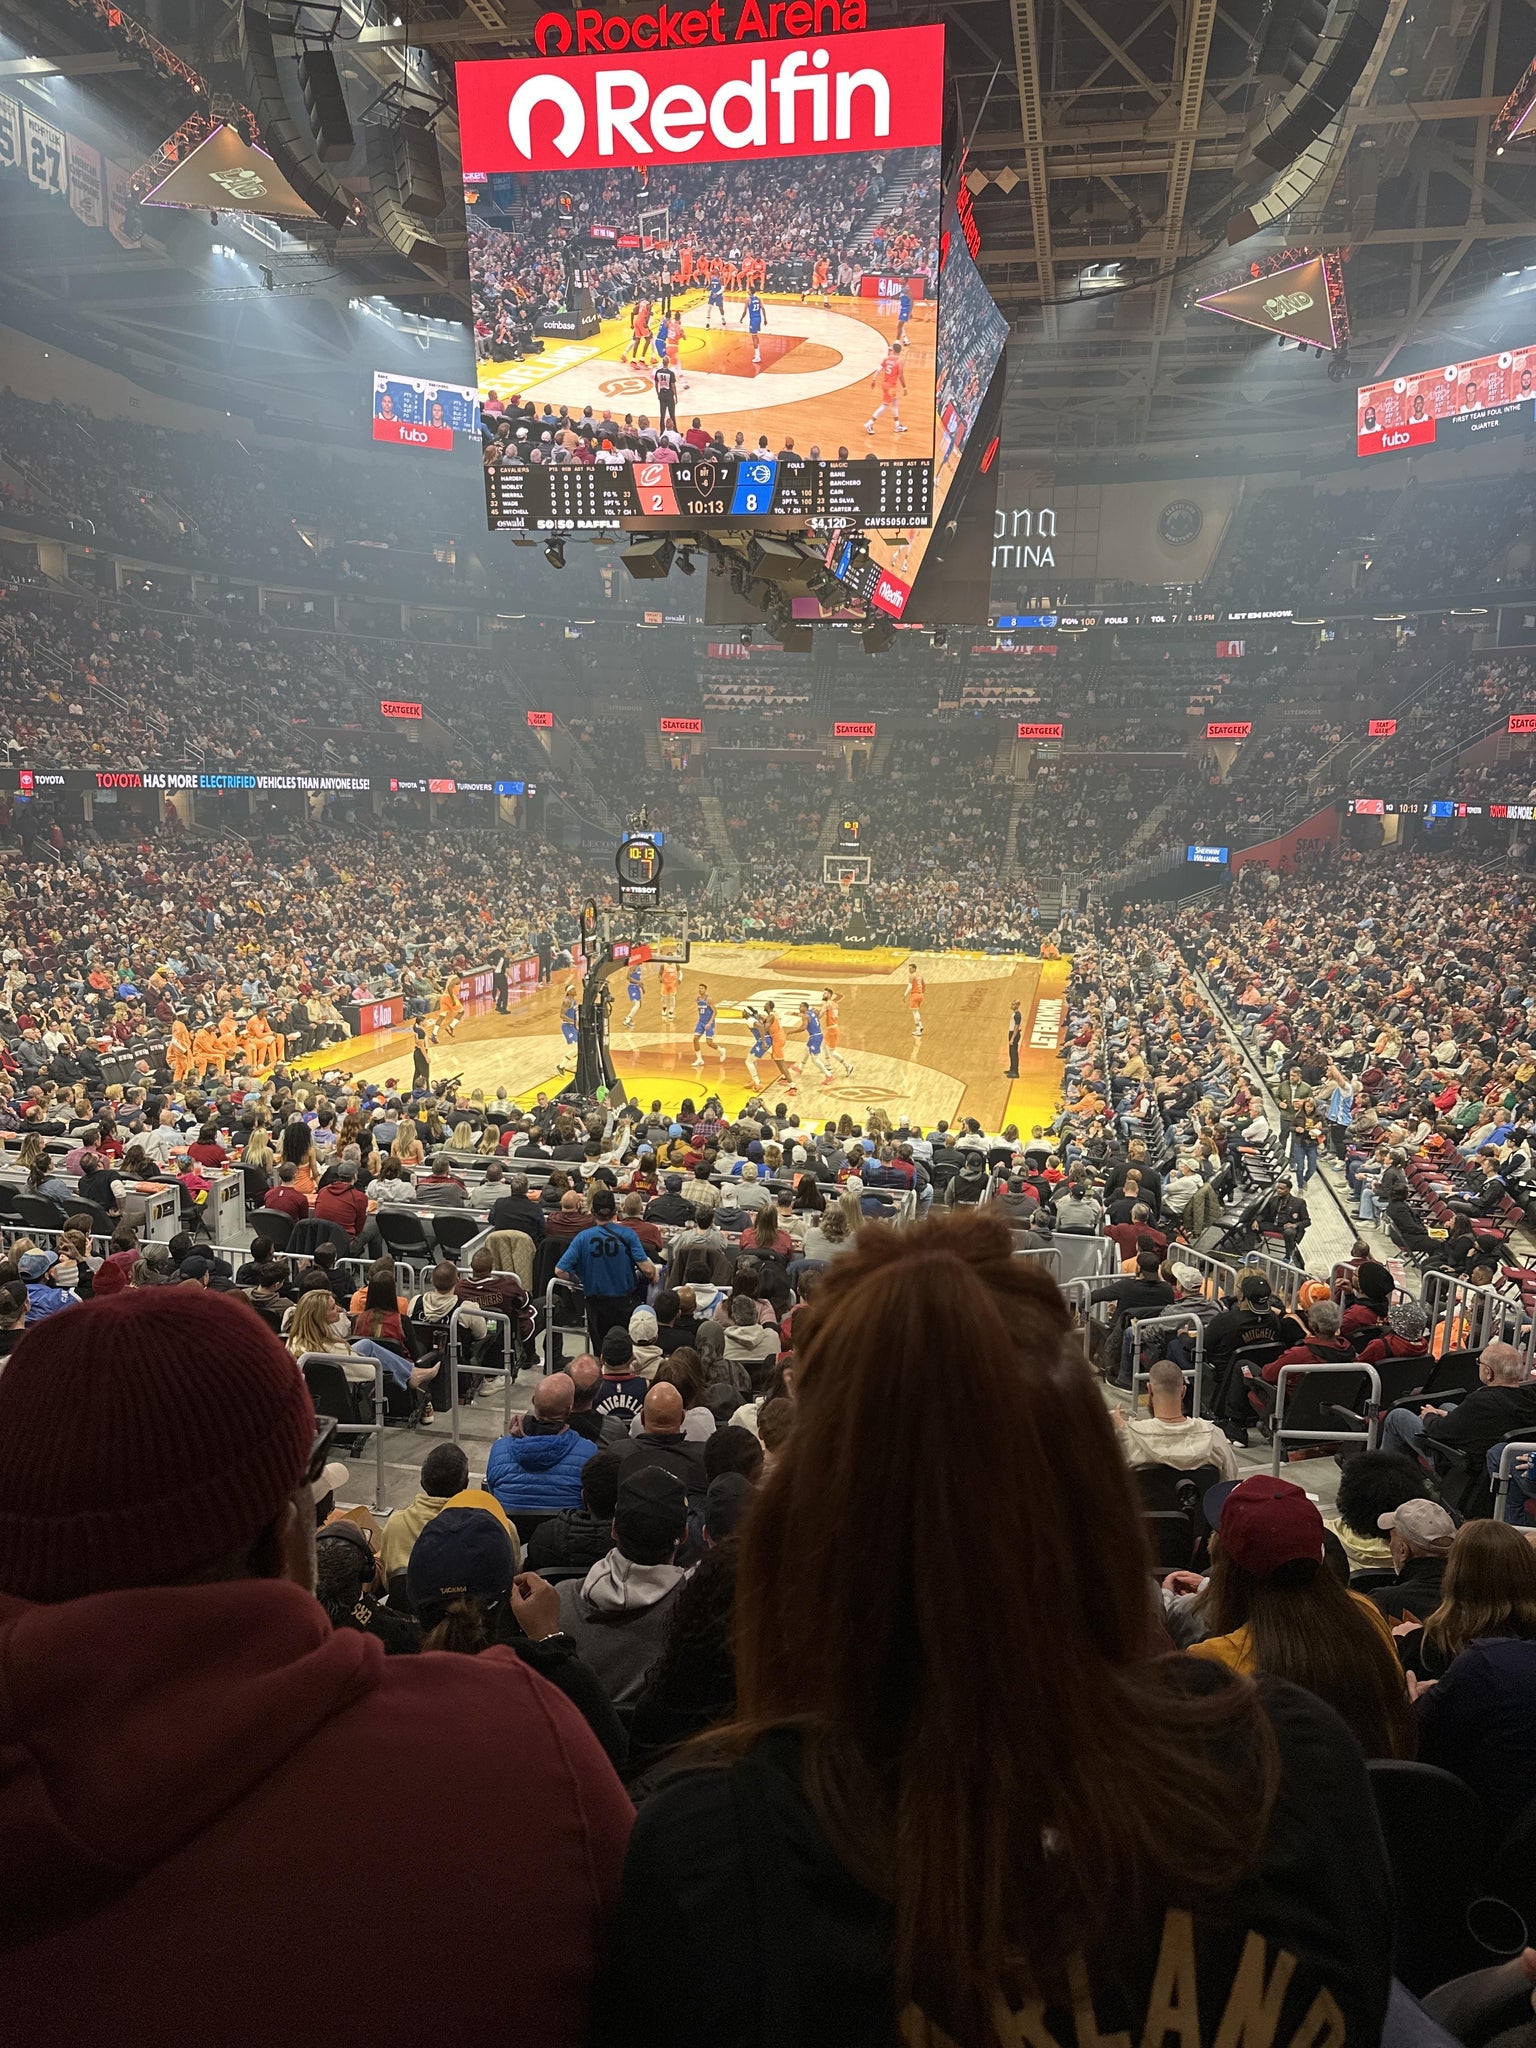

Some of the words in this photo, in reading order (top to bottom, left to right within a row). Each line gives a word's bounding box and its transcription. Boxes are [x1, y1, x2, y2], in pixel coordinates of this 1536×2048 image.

[575, 0, 726, 54] Rocket
[735, 0, 867, 41] Arena
[595, 48, 890, 156] Redfin
[30, 136, 61, 187] 27
[753, 303, 760, 312] 23
[1262, 291, 1314, 321] LAND
[543, 319, 576, 330] coinbase
[885, 365, 892, 375] 5
[1453, 413, 1468, 423] FIRST
[1470, 410, 1486, 420] TEAM
[1487, 408, 1502, 417] FOUL
[399, 426, 428, 442] fubo
[1382, 431, 1410, 447] fubo
[676, 470, 691, 481] 1Q
[721, 470, 728, 479] 7
[652, 495, 663, 511] 2
[687, 501, 724, 513] 10:13
[746, 494, 757, 511] 8
[497, 517, 525, 528] oswald
[577, 519, 620, 529] RAFFLE
[811, 518, 847, 530] $4,120
[865, 516, 928, 526] CAVS5050.COM
[1011, 618, 1017, 626] 8
[1081, 617, 1096, 626] 100
[1105, 616, 1128, 624] FOULS
[1135, 616, 1140, 624] 1
[1151, 615, 1166, 623] TOL
[1171, 614, 1177, 623] 7
[1247, 611, 1262, 619] EM
[383, 704, 420, 716] SEATGEEK
[662, 720, 700, 730] SEATGEEK
[836, 725, 874, 734] SEATGEEK
[1020, 726, 1060, 736] SEATGEEK
[1208, 725, 1250, 735] SEATGEEK
[35, 775, 65, 785] TOYOTA
[96, 773, 142, 788] TOYOTA
[143, 774, 166, 788] HAS
[170, 774, 199, 789] MORE
[200, 775, 256, 789] ELECTRIFIED
[257, 777, 296, 789] VEHICLES
[297, 777, 319, 789] THAN
[320, 778, 351, 789] ANYONE
[351, 779, 370, 790] ELSE!
[448, 783, 453, 791] 0
[457, 783, 492, 791] TURNOVERS
[1376, 803, 1382, 812] 2
[1400, 804, 1417, 814] 10:13
[1423, 804, 1428, 813] 7
[1431, 805, 1437, 815] 8
[1490, 805, 1507, 817] TOYOTA
[1507, 806, 1518, 818] HAS
[1518, 806, 1533, 819] MORE
[582, 840, 618, 849] LECOM
[1296, 838, 1320, 850] SEAT
[629, 847, 655, 860] 10:13
[1194, 847, 1221, 856] SHERWIN
[640, 859, 653, 880] 7
[631, 886, 657, 894] TISSOT
[588, 1236, 620, 1258] 30
[1241, 1327, 1276, 1344] MITCHELL
[595, 1393, 644, 1416] MITCHELL
